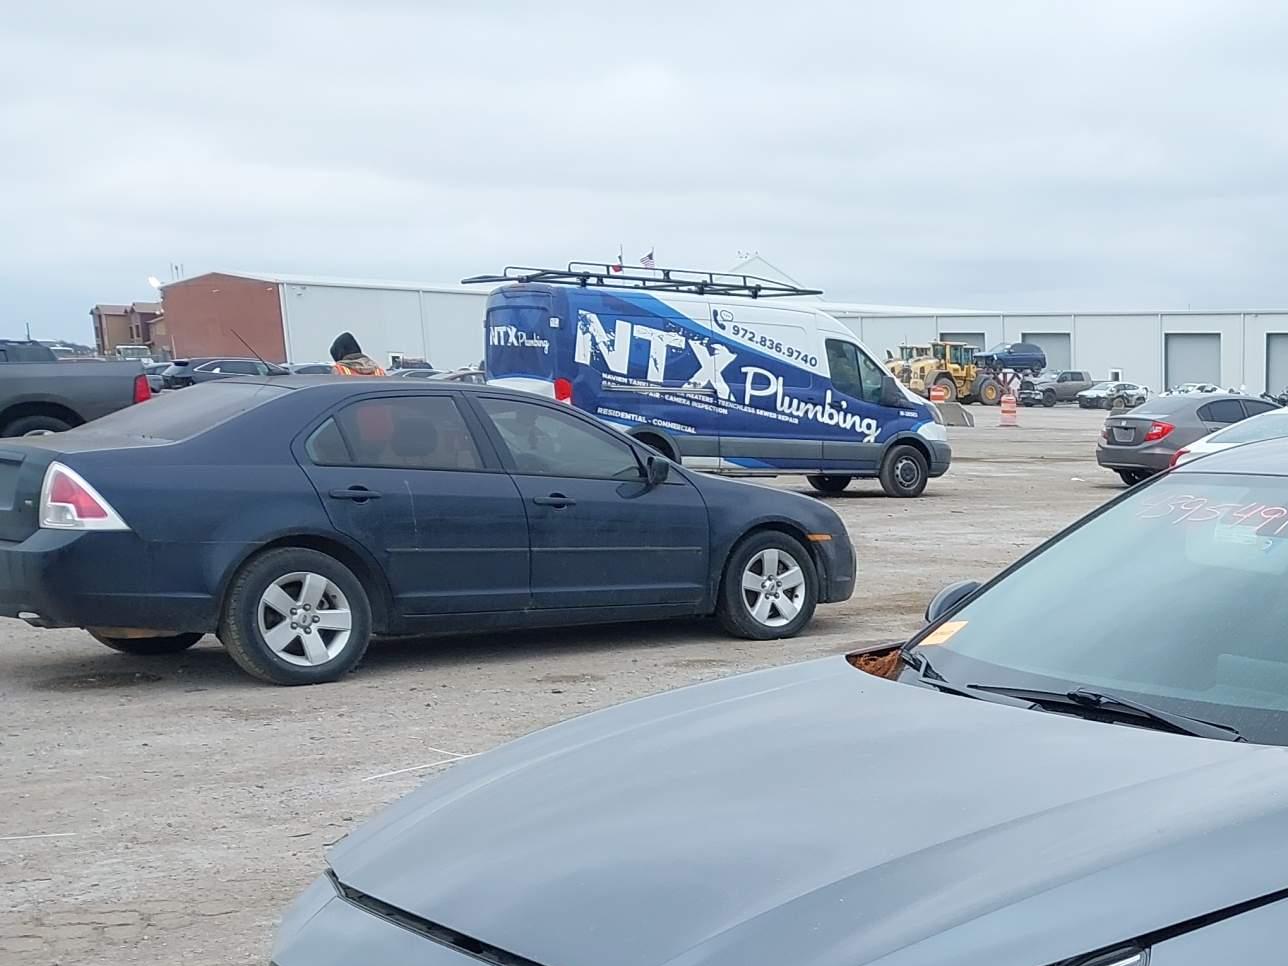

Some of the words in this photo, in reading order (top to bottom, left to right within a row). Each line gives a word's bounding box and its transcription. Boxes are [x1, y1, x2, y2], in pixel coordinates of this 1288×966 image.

[489, 326, 518, 346] NTX
[732, 324, 818, 368] 972.836.9740
[574, 309, 738, 401] NTX
[740, 366, 882, 443] Plumbing
[597, 407, 648, 424] RESIDENTIAL
[652, 418, 697, 434] COMMERCIAL
